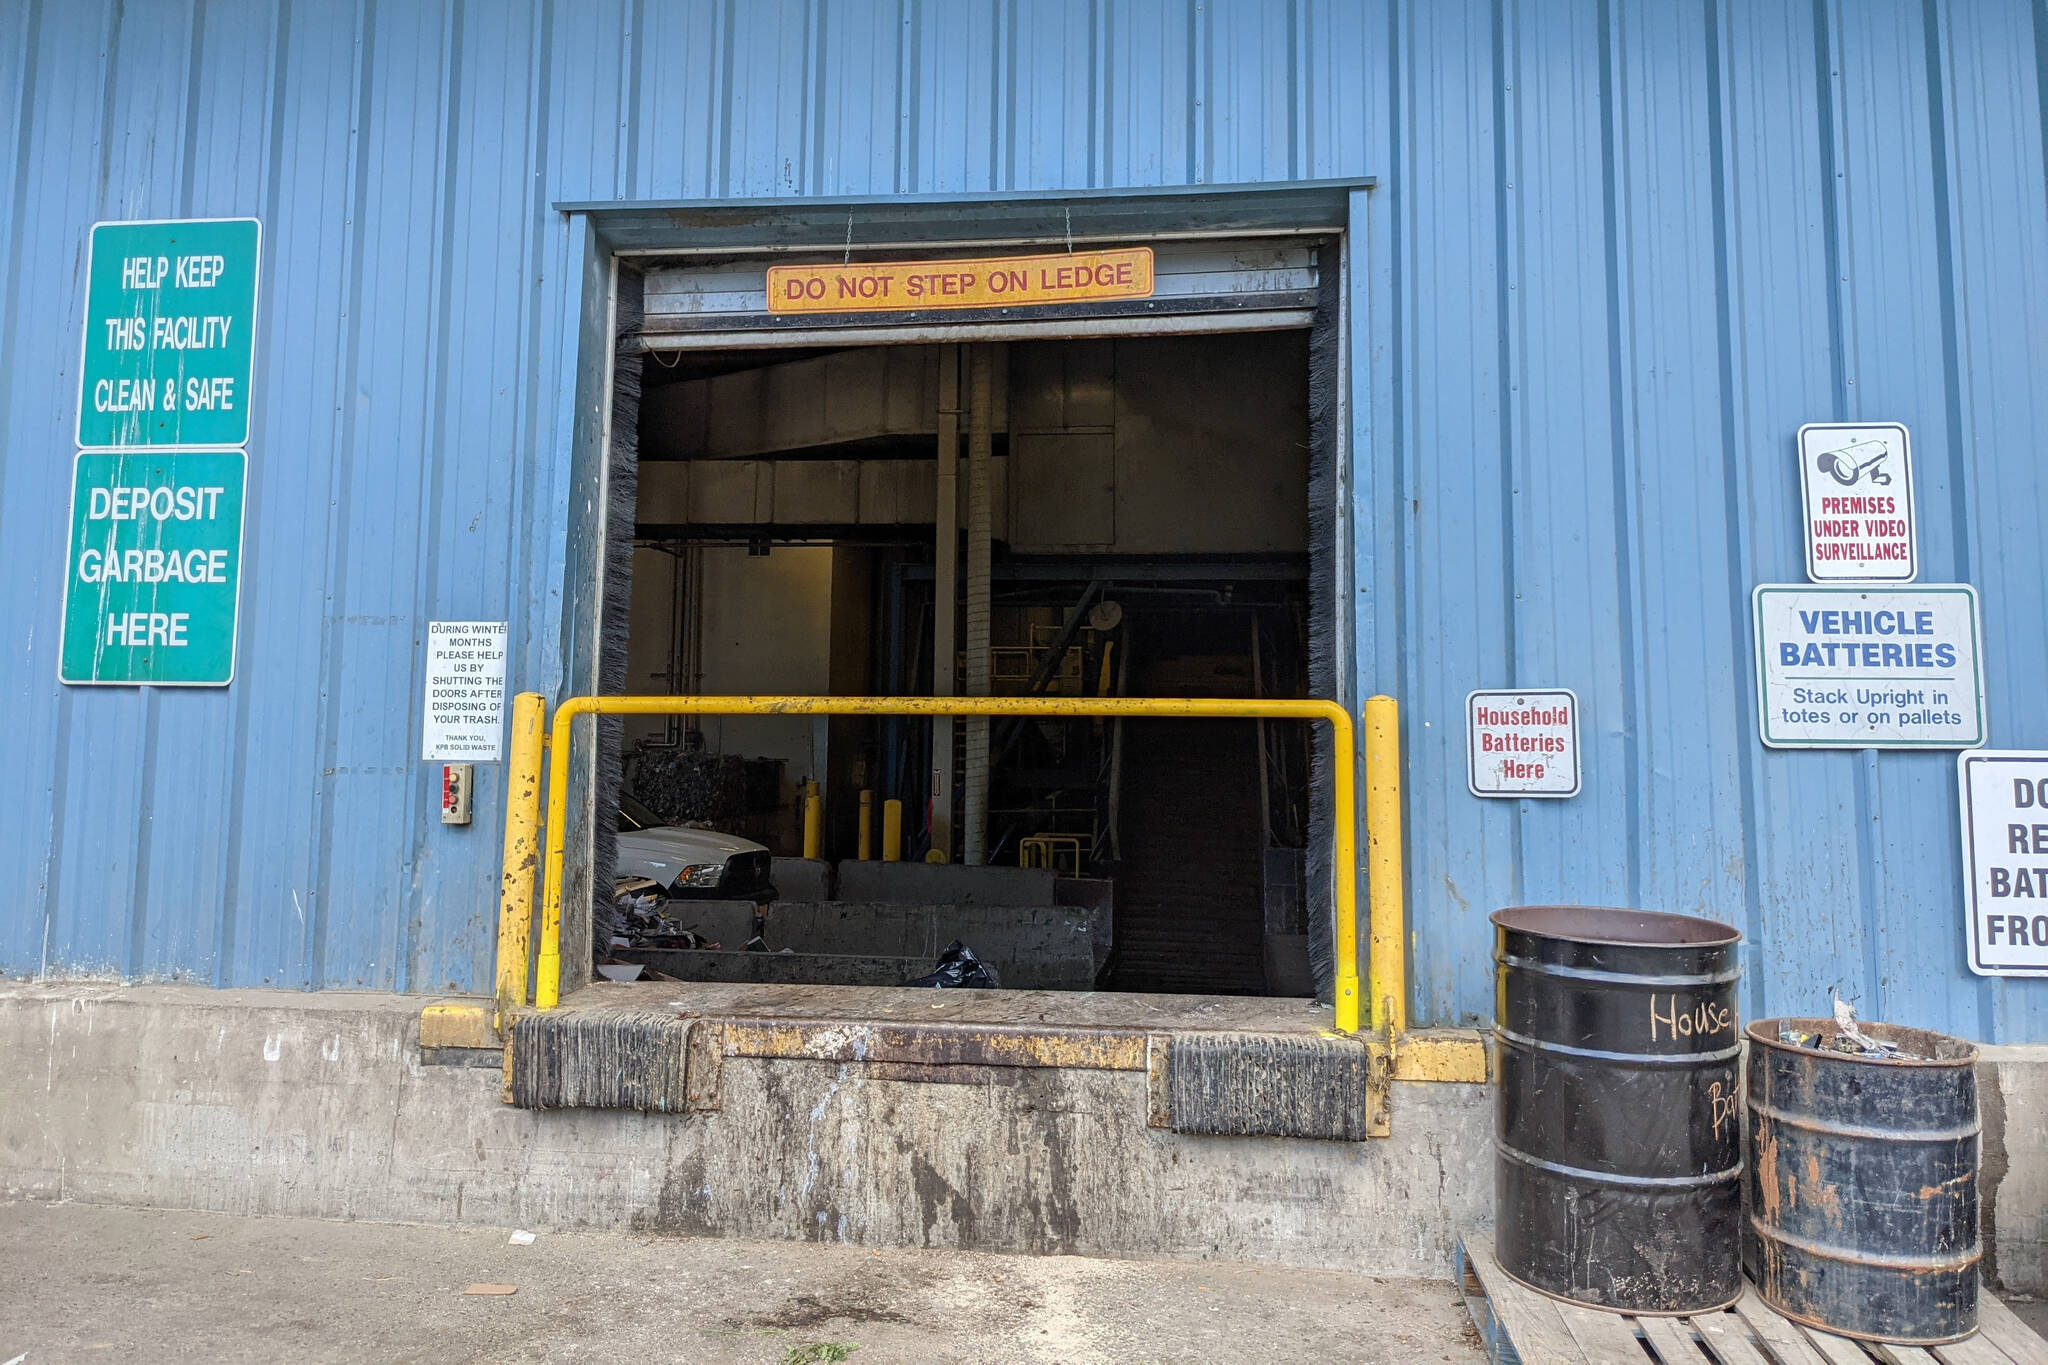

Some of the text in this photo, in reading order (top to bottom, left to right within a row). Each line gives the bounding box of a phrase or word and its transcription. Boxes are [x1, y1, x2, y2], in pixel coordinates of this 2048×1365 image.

[122, 255, 225, 289] HELP KEEP
[786, 262, 1133, 301] DO NOT STEP ON LEDGE
[105, 316, 232, 350] THIS FACILITY
[94, 377, 234, 413] CLEAN & SAFE
[89, 486, 225, 521] DEPOSIT
[1822, 496, 1896, 515] PREMISES
[1814, 519, 1906, 538] UNDER VIDEO
[1815, 542, 1908, 561] SURVEILLANCE
[79, 549, 228, 583] GARBAGE
[107, 613, 190, 646] HERE
[431, 625, 469, 634] DURING
[1798, 610, 1934, 635] VEHICLE
[449, 638, 492, 647] MONTHS
[436, 651, 504, 660] PLEASE HELP
[1779, 642, 1957, 668] BATTERIES
[453, 664, 485, 673] US BY
[432, 676, 503, 686] SHUTTING THE
[432, 689, 502, 698] DOORS AFTER
[1793, 687, 1949, 708] Stack Upright in
[432, 702, 486, 711] DISPOSING
[1477, 706, 1568, 726] Household
[433, 715, 461, 724] YOUR
[1782, 708, 1962, 727] totes or on pallets
[1482, 733, 1565, 752] Batteries
[1503, 759, 1545, 779] Here
[2007, 823, 2048, 854] RE
[1990, 867, 2048, 898] BAT
[1986, 914, 2048, 947] FRO
